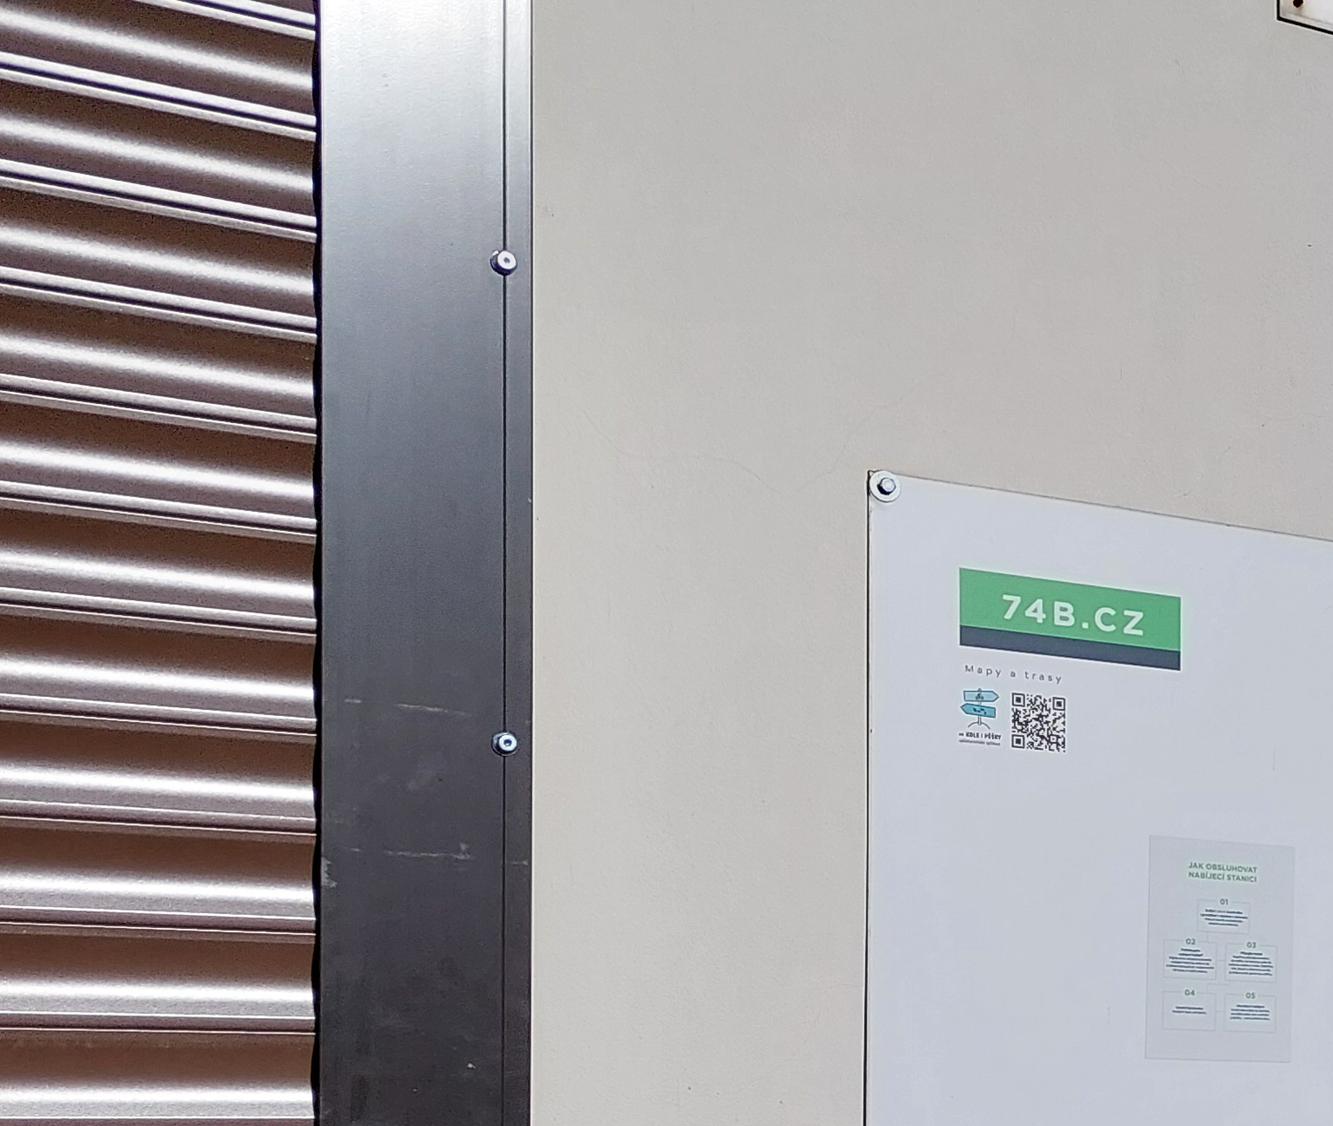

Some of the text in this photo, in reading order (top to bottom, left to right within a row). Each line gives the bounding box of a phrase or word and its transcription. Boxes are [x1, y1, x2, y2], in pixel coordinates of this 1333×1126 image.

[1002, 594, 1144, 636] 74B.CZ
[965, 665, 1001, 678] Mapy
[1024, 671, 1062, 684] trasy
[1205, 863, 1257, 873] OBSLUHOVAT
[1227, 874, 1257, 883] STANICI
